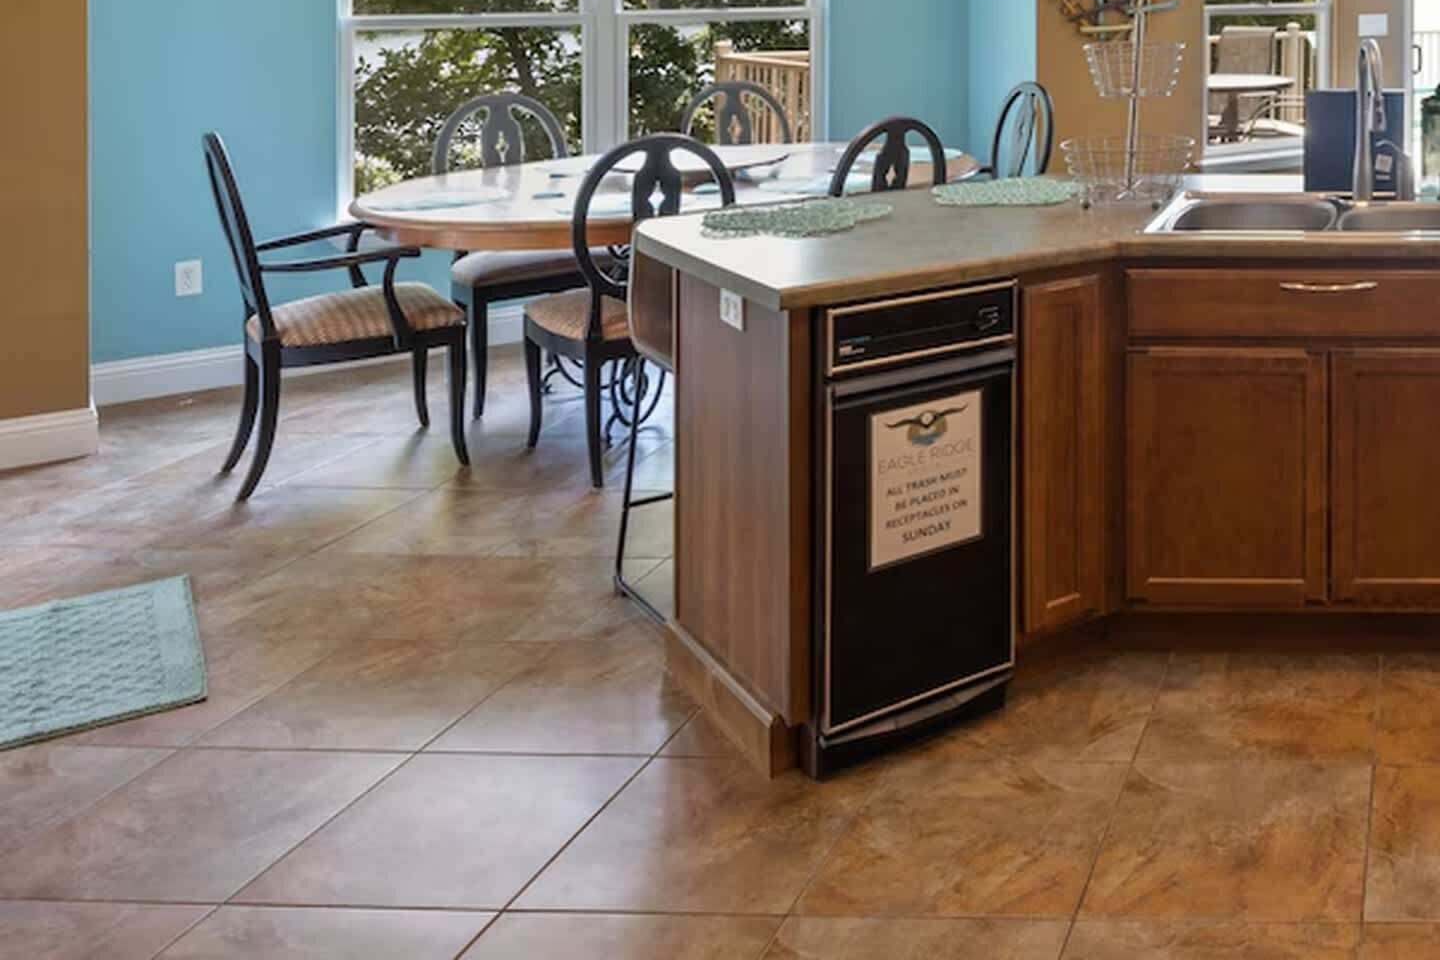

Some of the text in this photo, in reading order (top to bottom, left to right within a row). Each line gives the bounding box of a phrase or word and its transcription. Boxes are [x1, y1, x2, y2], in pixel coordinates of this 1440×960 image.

[879, 449, 926, 474] EAGLE
[929, 437, 976, 457] RIDGE
[886, 487, 904, 497] ALL
[906, 476, 938, 491] TRASH
[939, 467, 968, 481] MUST
[894, 485, 960, 512] BE PLACED IN
[885, 499, 968, 529] RECEPTACLES ON
[901, 520, 951, 544] SUNDAY
